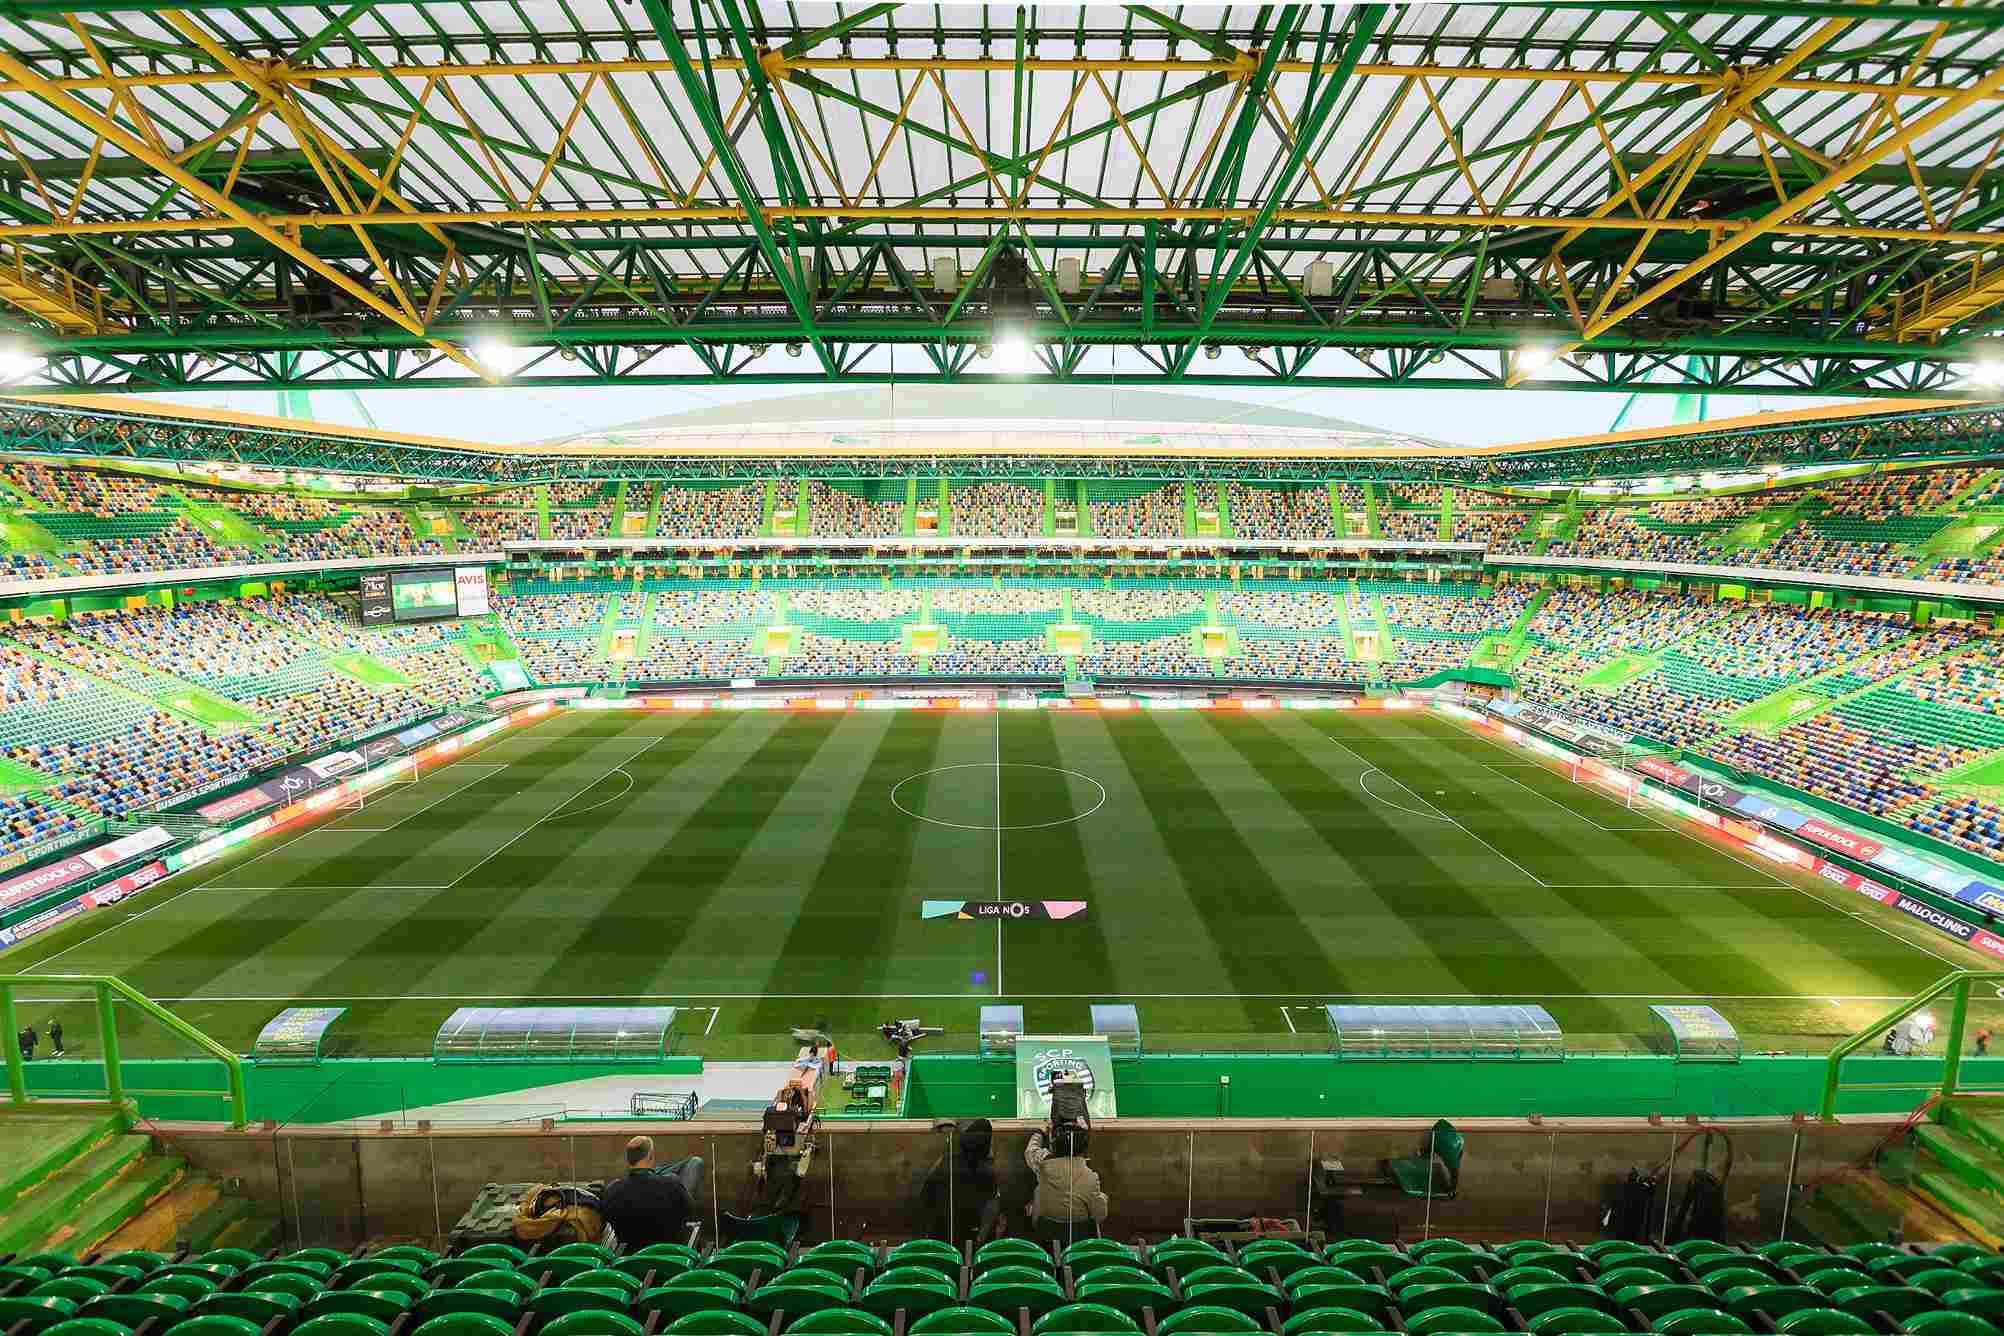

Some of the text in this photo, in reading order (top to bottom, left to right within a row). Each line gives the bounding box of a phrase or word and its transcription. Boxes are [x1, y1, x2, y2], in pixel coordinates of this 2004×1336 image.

[457, 575, 484, 584] AVIS
[979, 906, 999, 914] LIGA
[1899, 899, 1971, 936] MALO CLINIC
